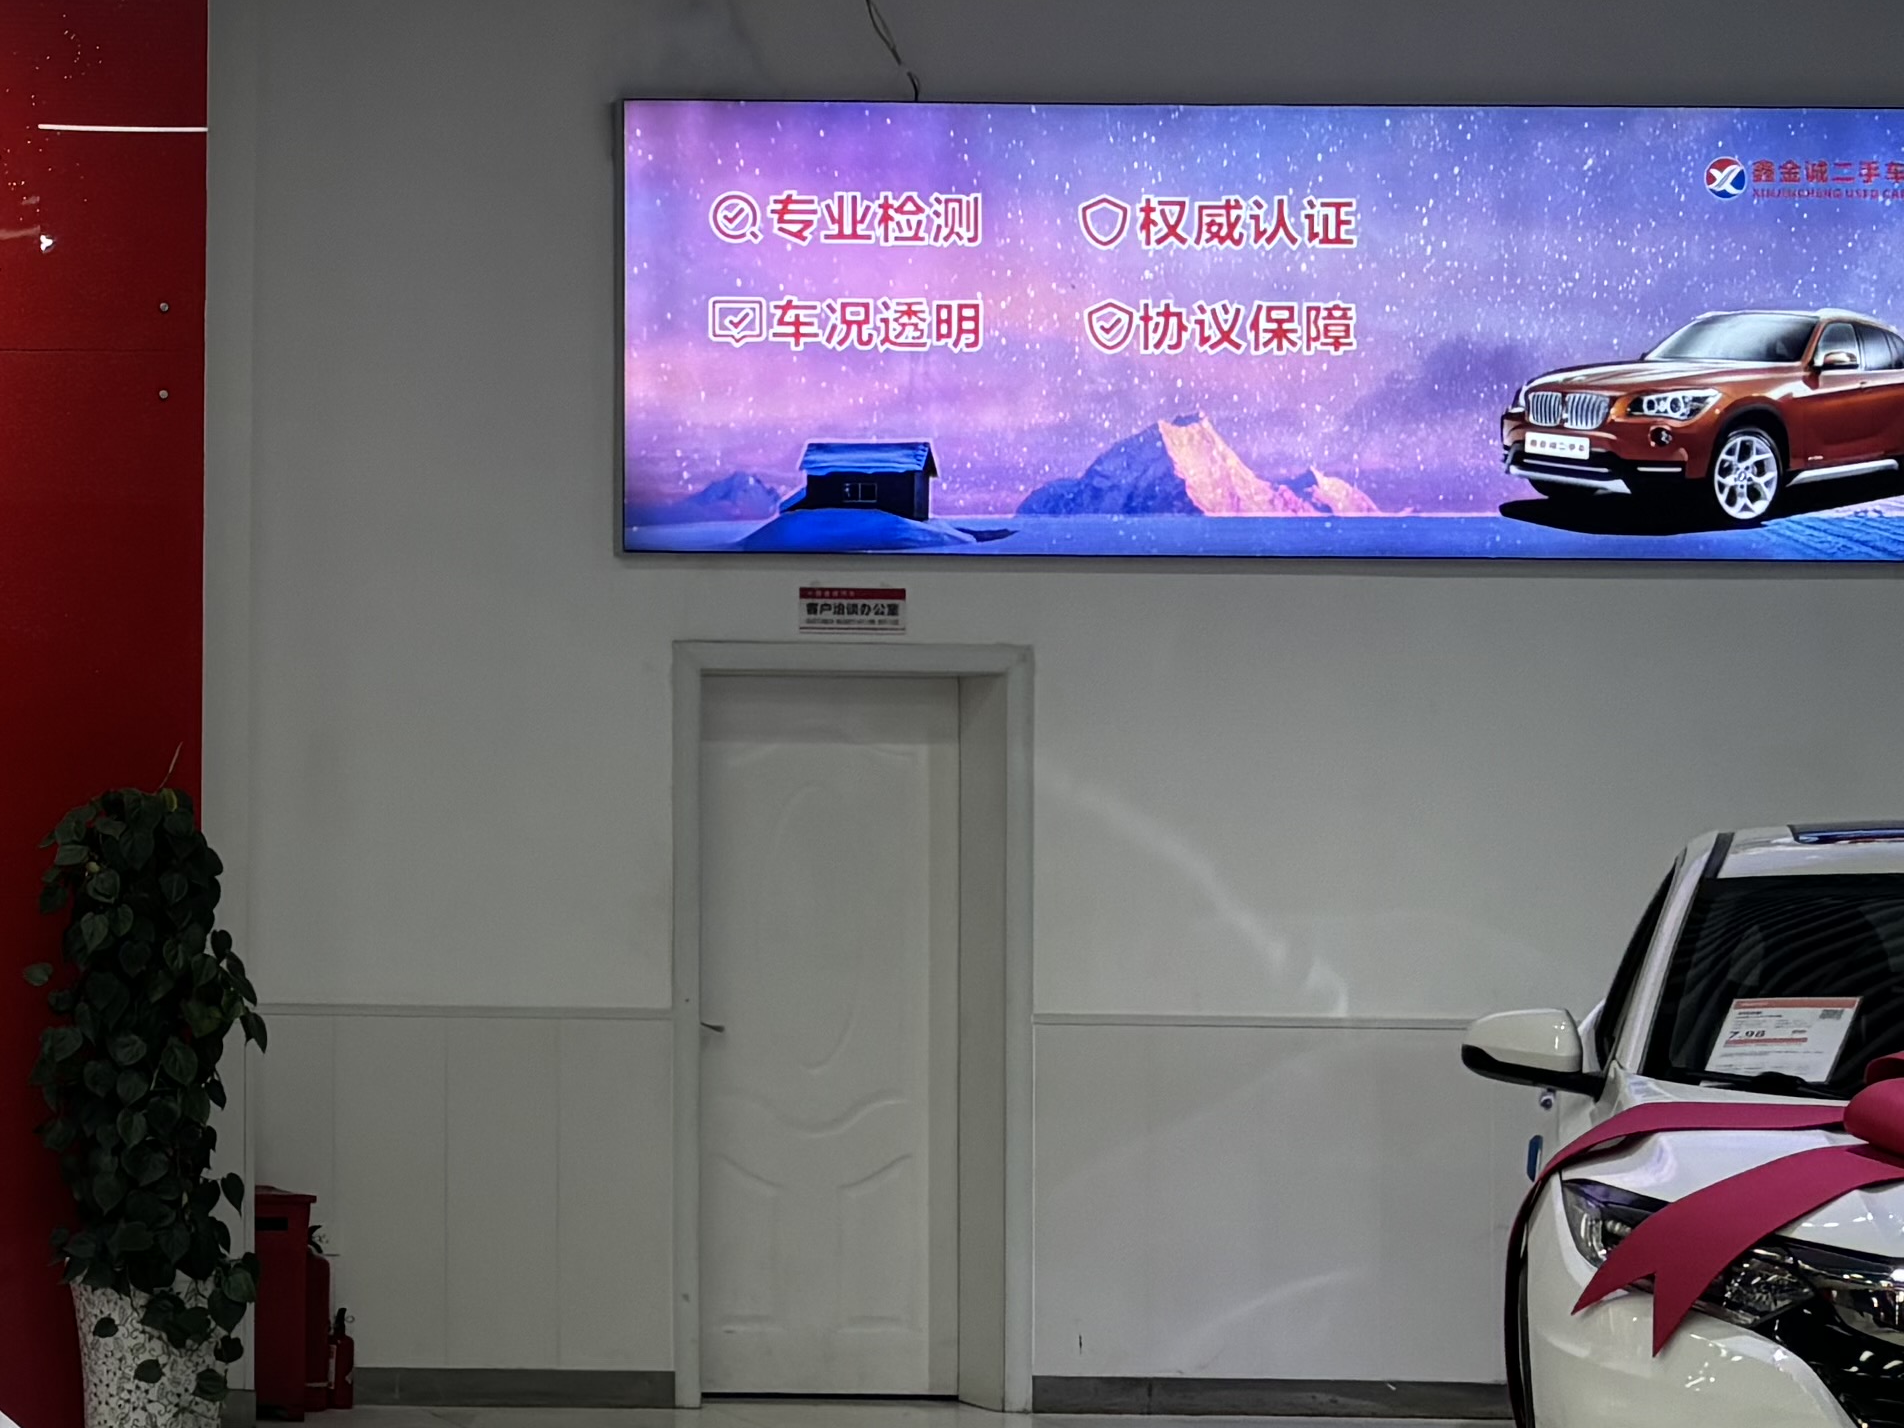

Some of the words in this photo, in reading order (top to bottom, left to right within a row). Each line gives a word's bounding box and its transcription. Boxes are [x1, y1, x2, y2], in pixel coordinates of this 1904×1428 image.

[769, 191, 983, 245] 专业检测
[1137, 193, 1358, 249] 权威认证
[770, 296, 985, 352] 车况透明
[1138, 298, 1359, 355] 协议保障
